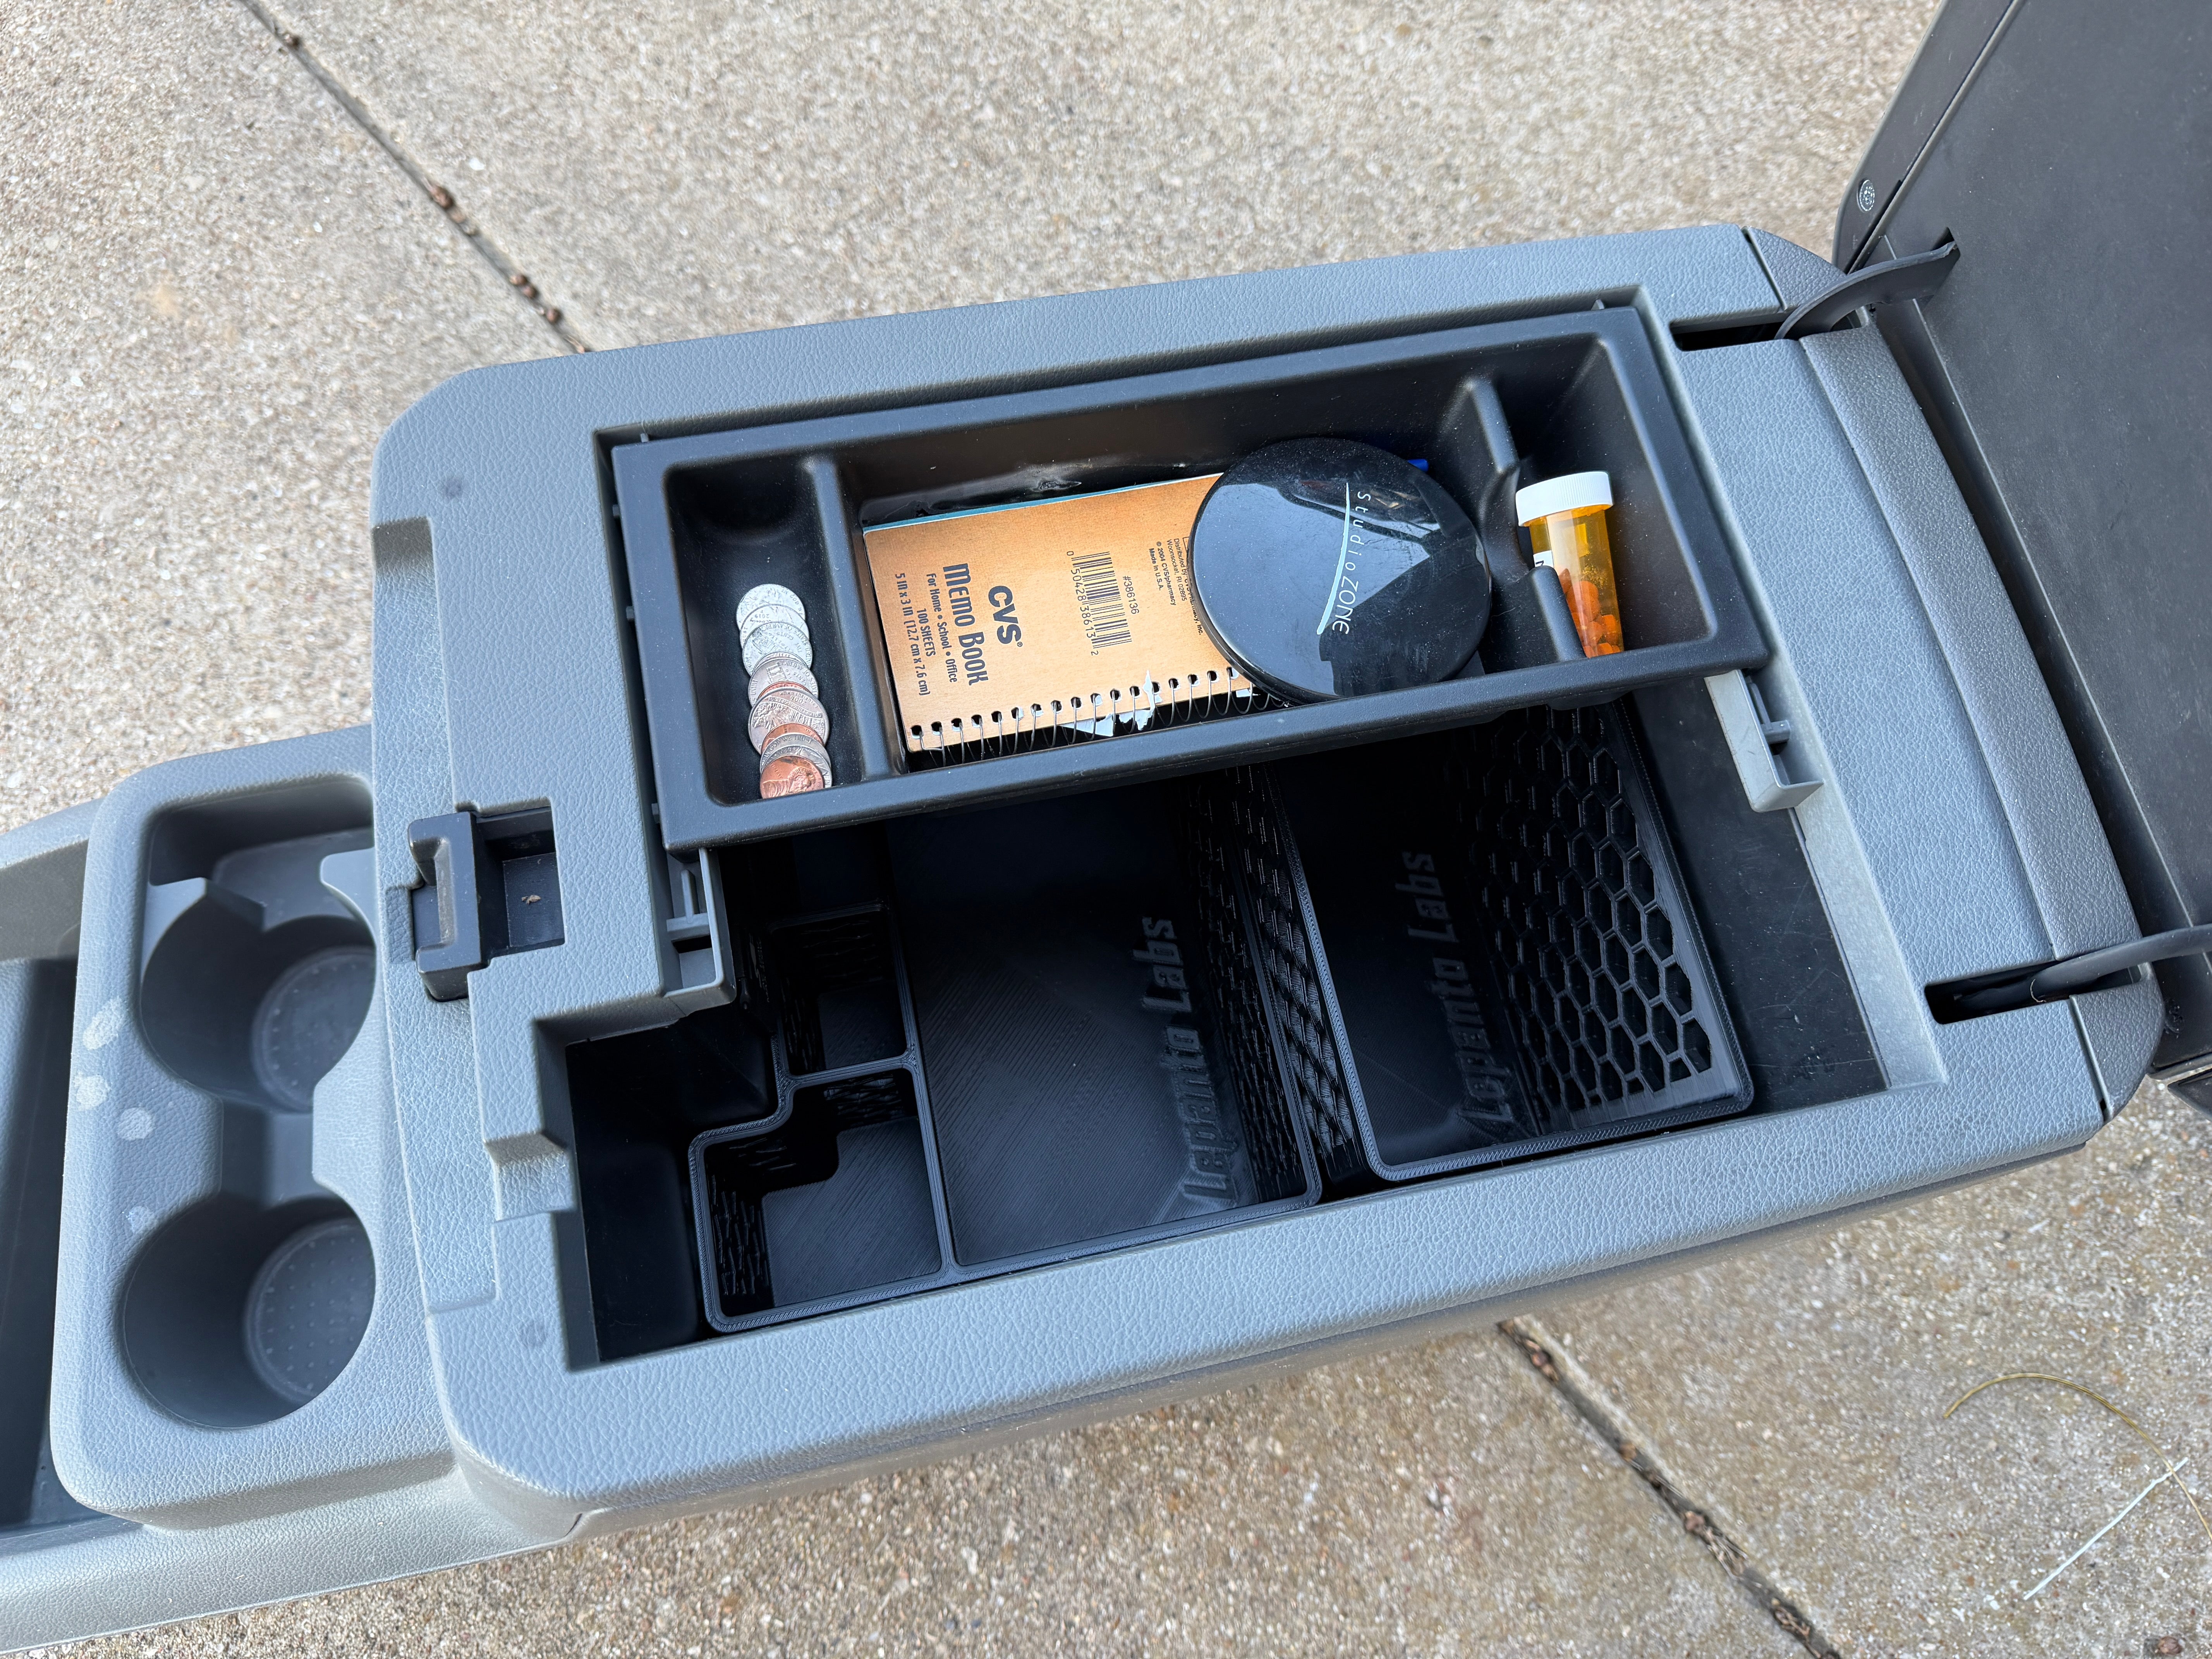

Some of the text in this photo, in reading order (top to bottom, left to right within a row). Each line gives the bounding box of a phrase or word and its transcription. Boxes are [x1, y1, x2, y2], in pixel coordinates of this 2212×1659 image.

[1149, 548, 1157, 565] Made
[1155, 572, 1164, 591] U.S.A.
[1158, 548, 1166, 562] 2004
[1162, 563, 1176, 606] CVS/pharmacy
[1166, 539, 1179, 575] Woonsocket,
[1178, 584, 1187, 601] 02895
[1174, 538, 1186, 568] Distributed
[1123, 575, 1140, 615] #386136
[1332, 577, 1359, 635] ZONE
[910, 644, 921, 657] cm
[917, 608, 936, 657] 100 SHEETS
[926, 573, 958, 683] For Home School Office
[915, 664, 927, 678] 7.6
[918, 680, 931, 696] cm)
[1395, 852, 1459, 943] Labs
[1130, 916, 1192, 1012] Labs
